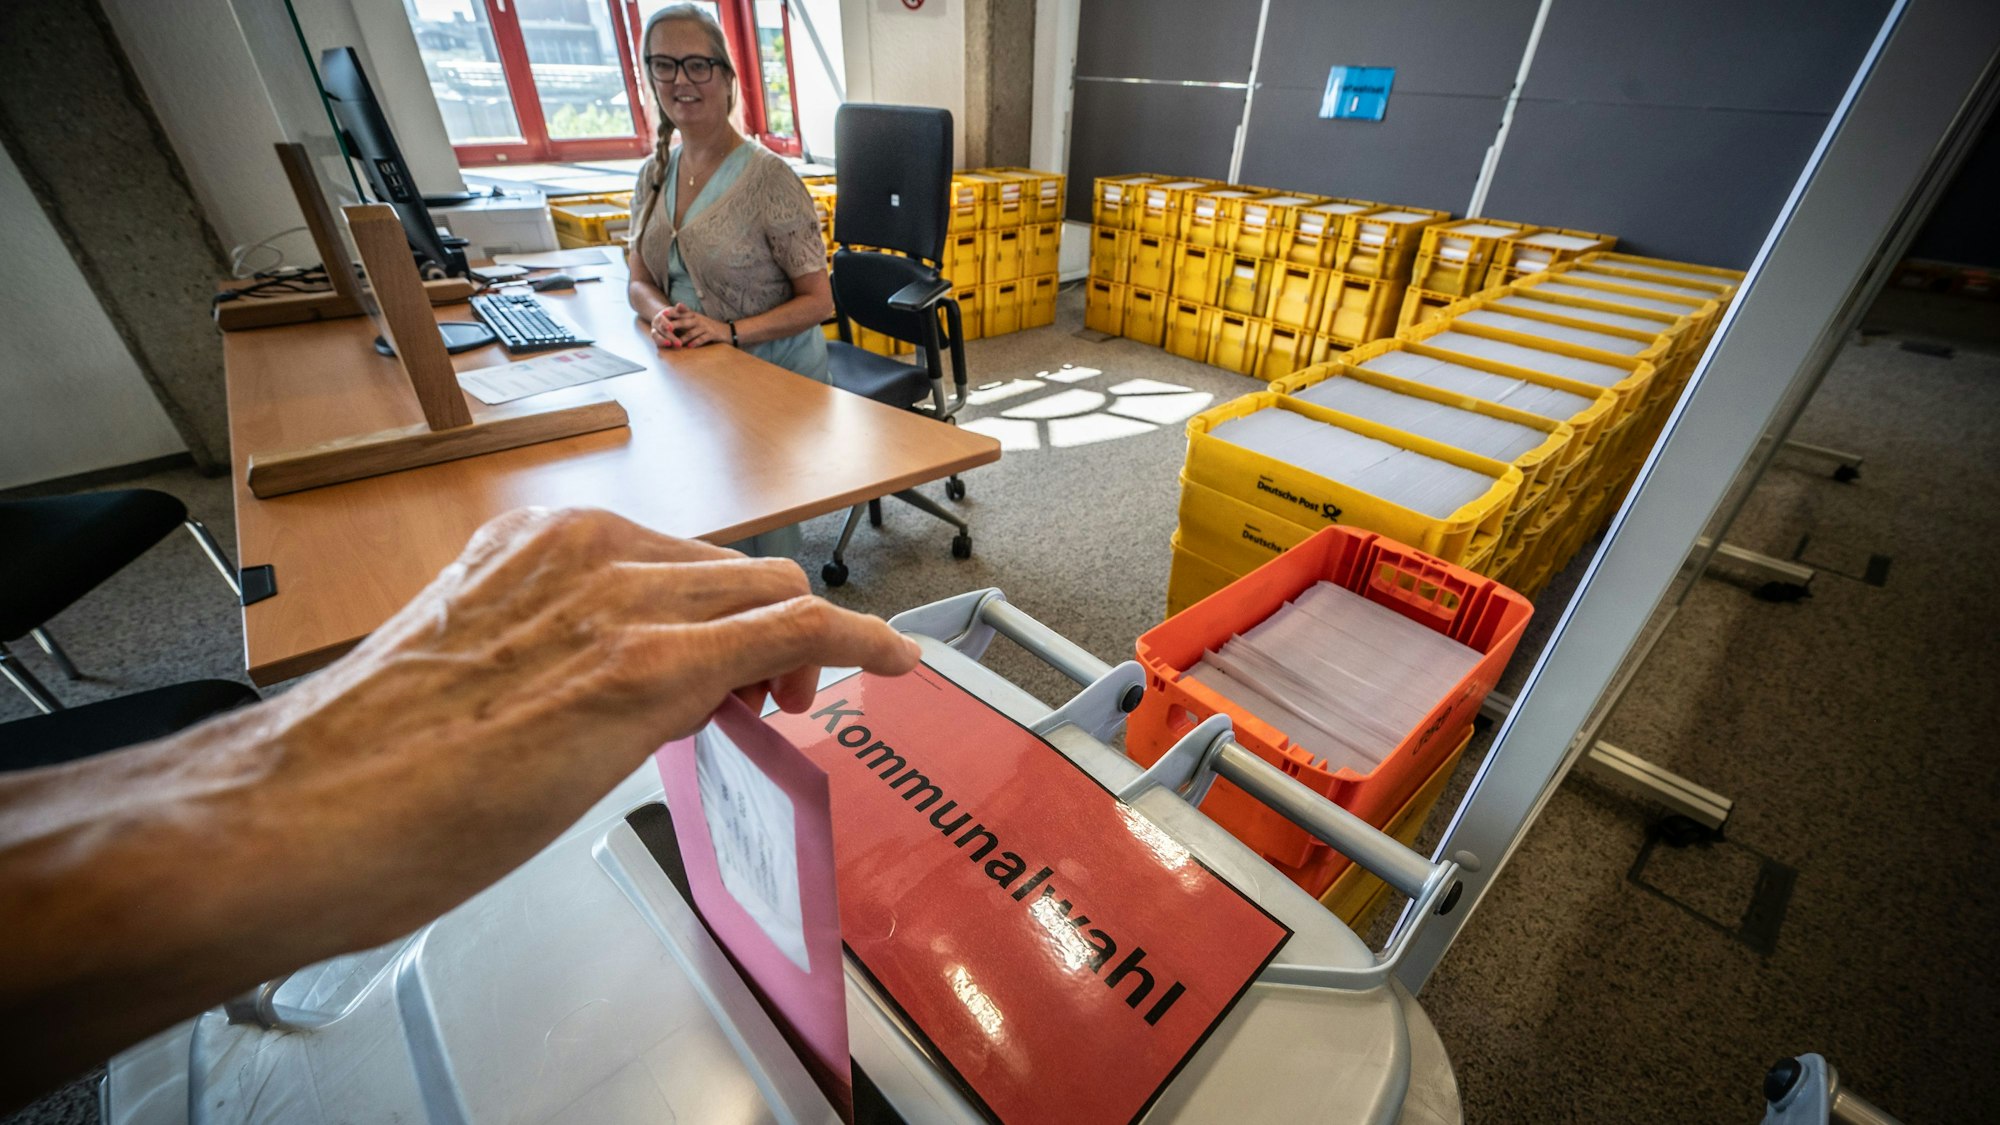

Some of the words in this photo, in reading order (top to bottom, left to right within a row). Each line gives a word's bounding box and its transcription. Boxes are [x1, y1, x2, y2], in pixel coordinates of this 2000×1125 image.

[1257, 480, 1298, 503] Deutsche
[1299, 496, 1319, 512] Post
[1242, 529, 1282, 553] Deutsche
